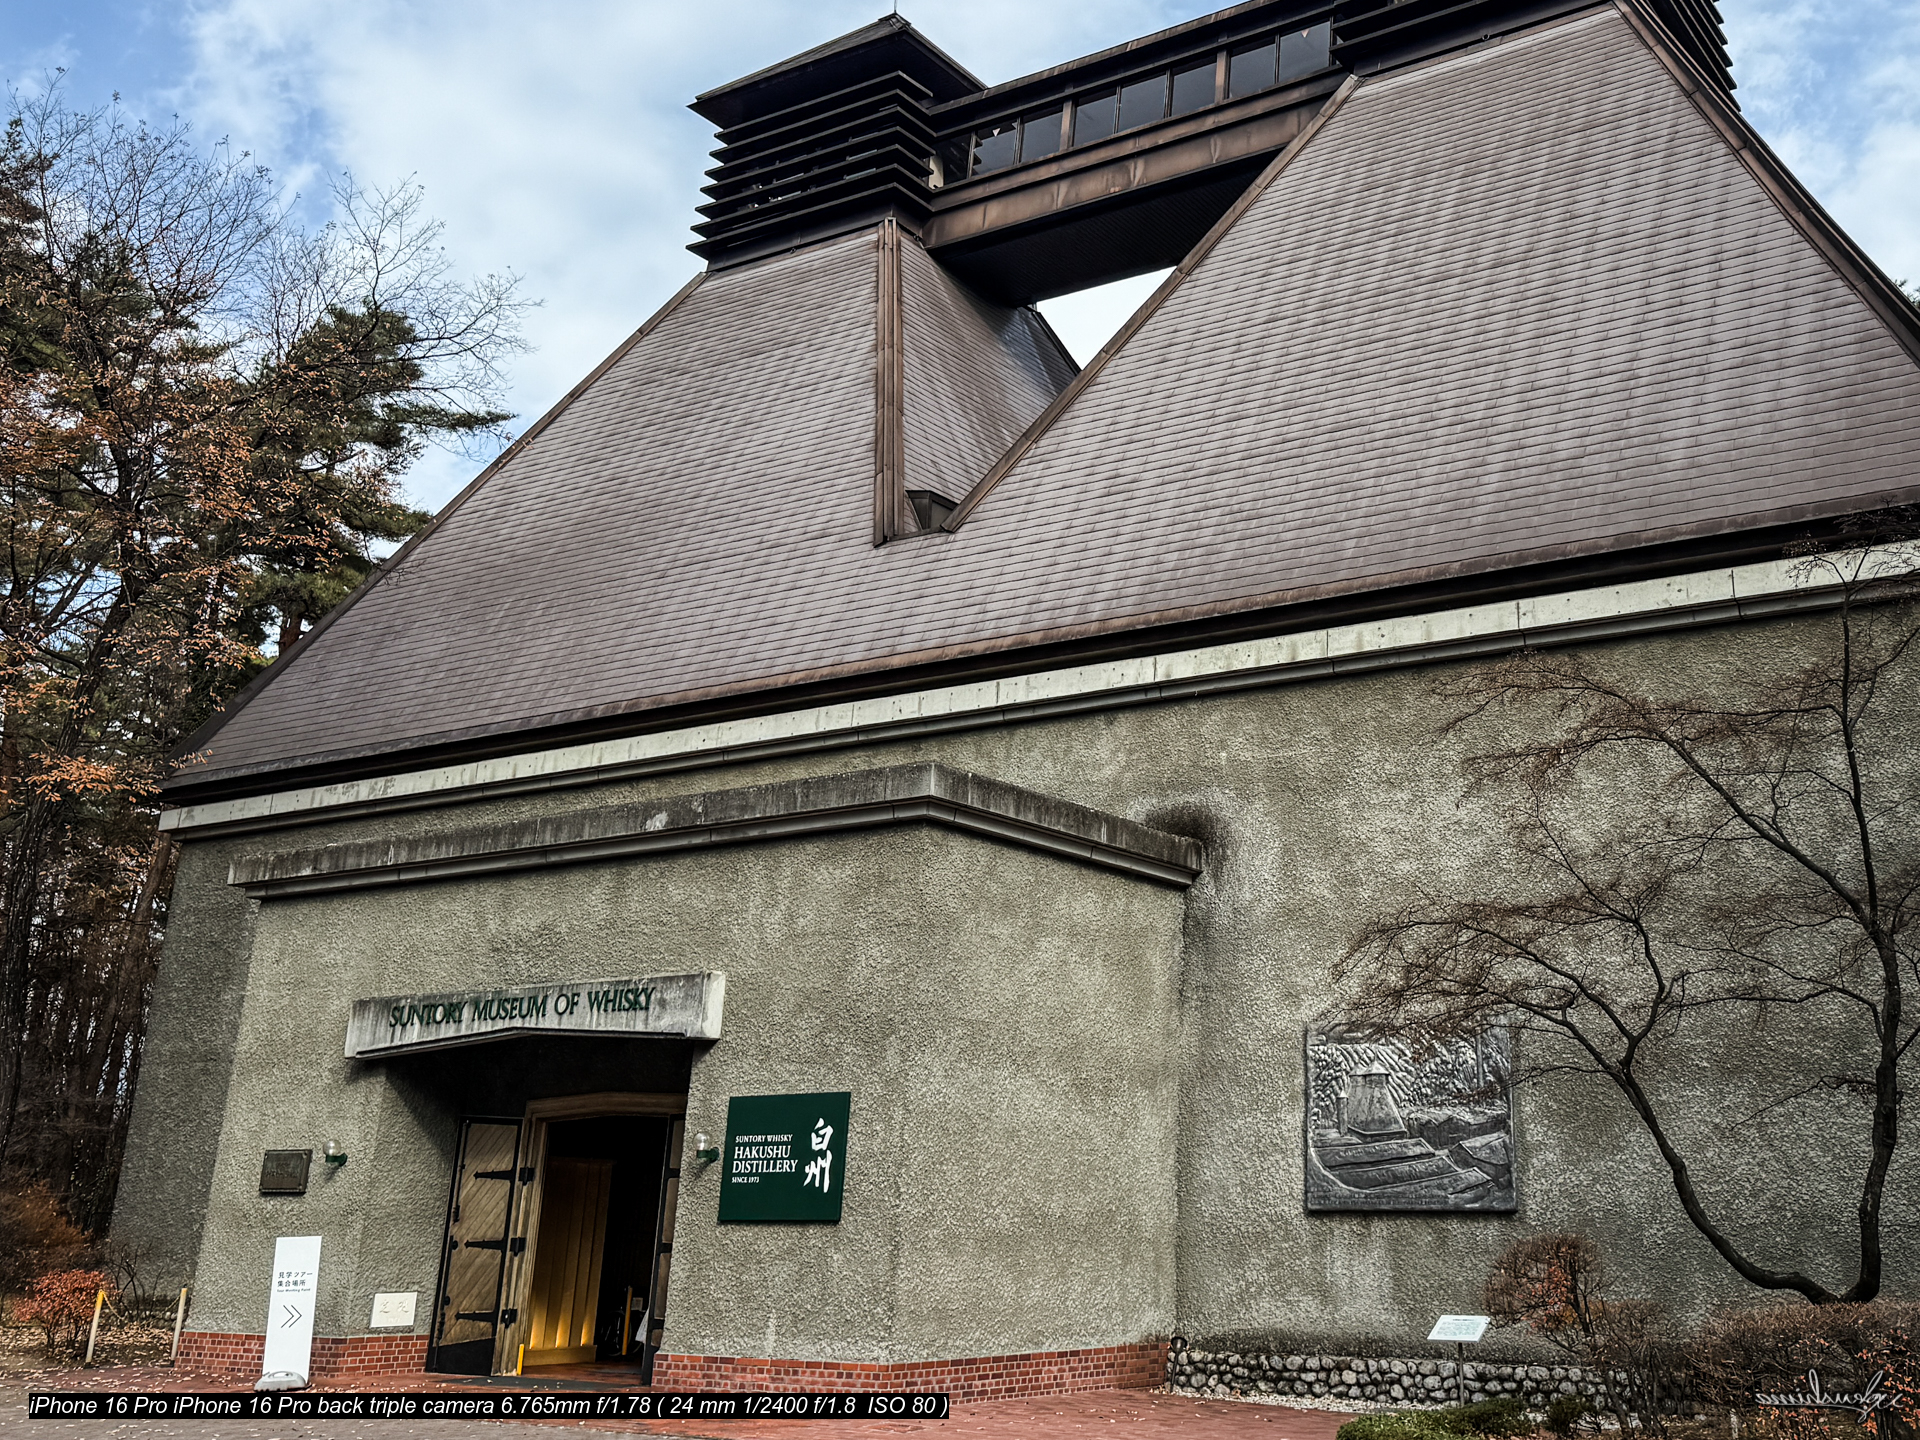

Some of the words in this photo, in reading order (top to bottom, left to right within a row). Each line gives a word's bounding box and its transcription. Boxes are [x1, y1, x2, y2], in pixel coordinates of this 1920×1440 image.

[389, 1000, 467, 1028] SUNTORY
[471, 994, 548, 1021] MUSEUM
[554, 992, 581, 1015] OF
[586, 986, 656, 1013] WHISKY
[735, 1135, 766, 1143] SUNTORY
[767, 1134, 793, 1142] WHISKY
[734, 1145, 791, 1159] HAKUSHU
[803, 1117, 834, 1194] 白州
[732, 1159, 799, 1173] DISTILLERY
[278, 1271, 313, 1279] 見学ツアー
[277, 1279, 306, 1287] 集合場所
